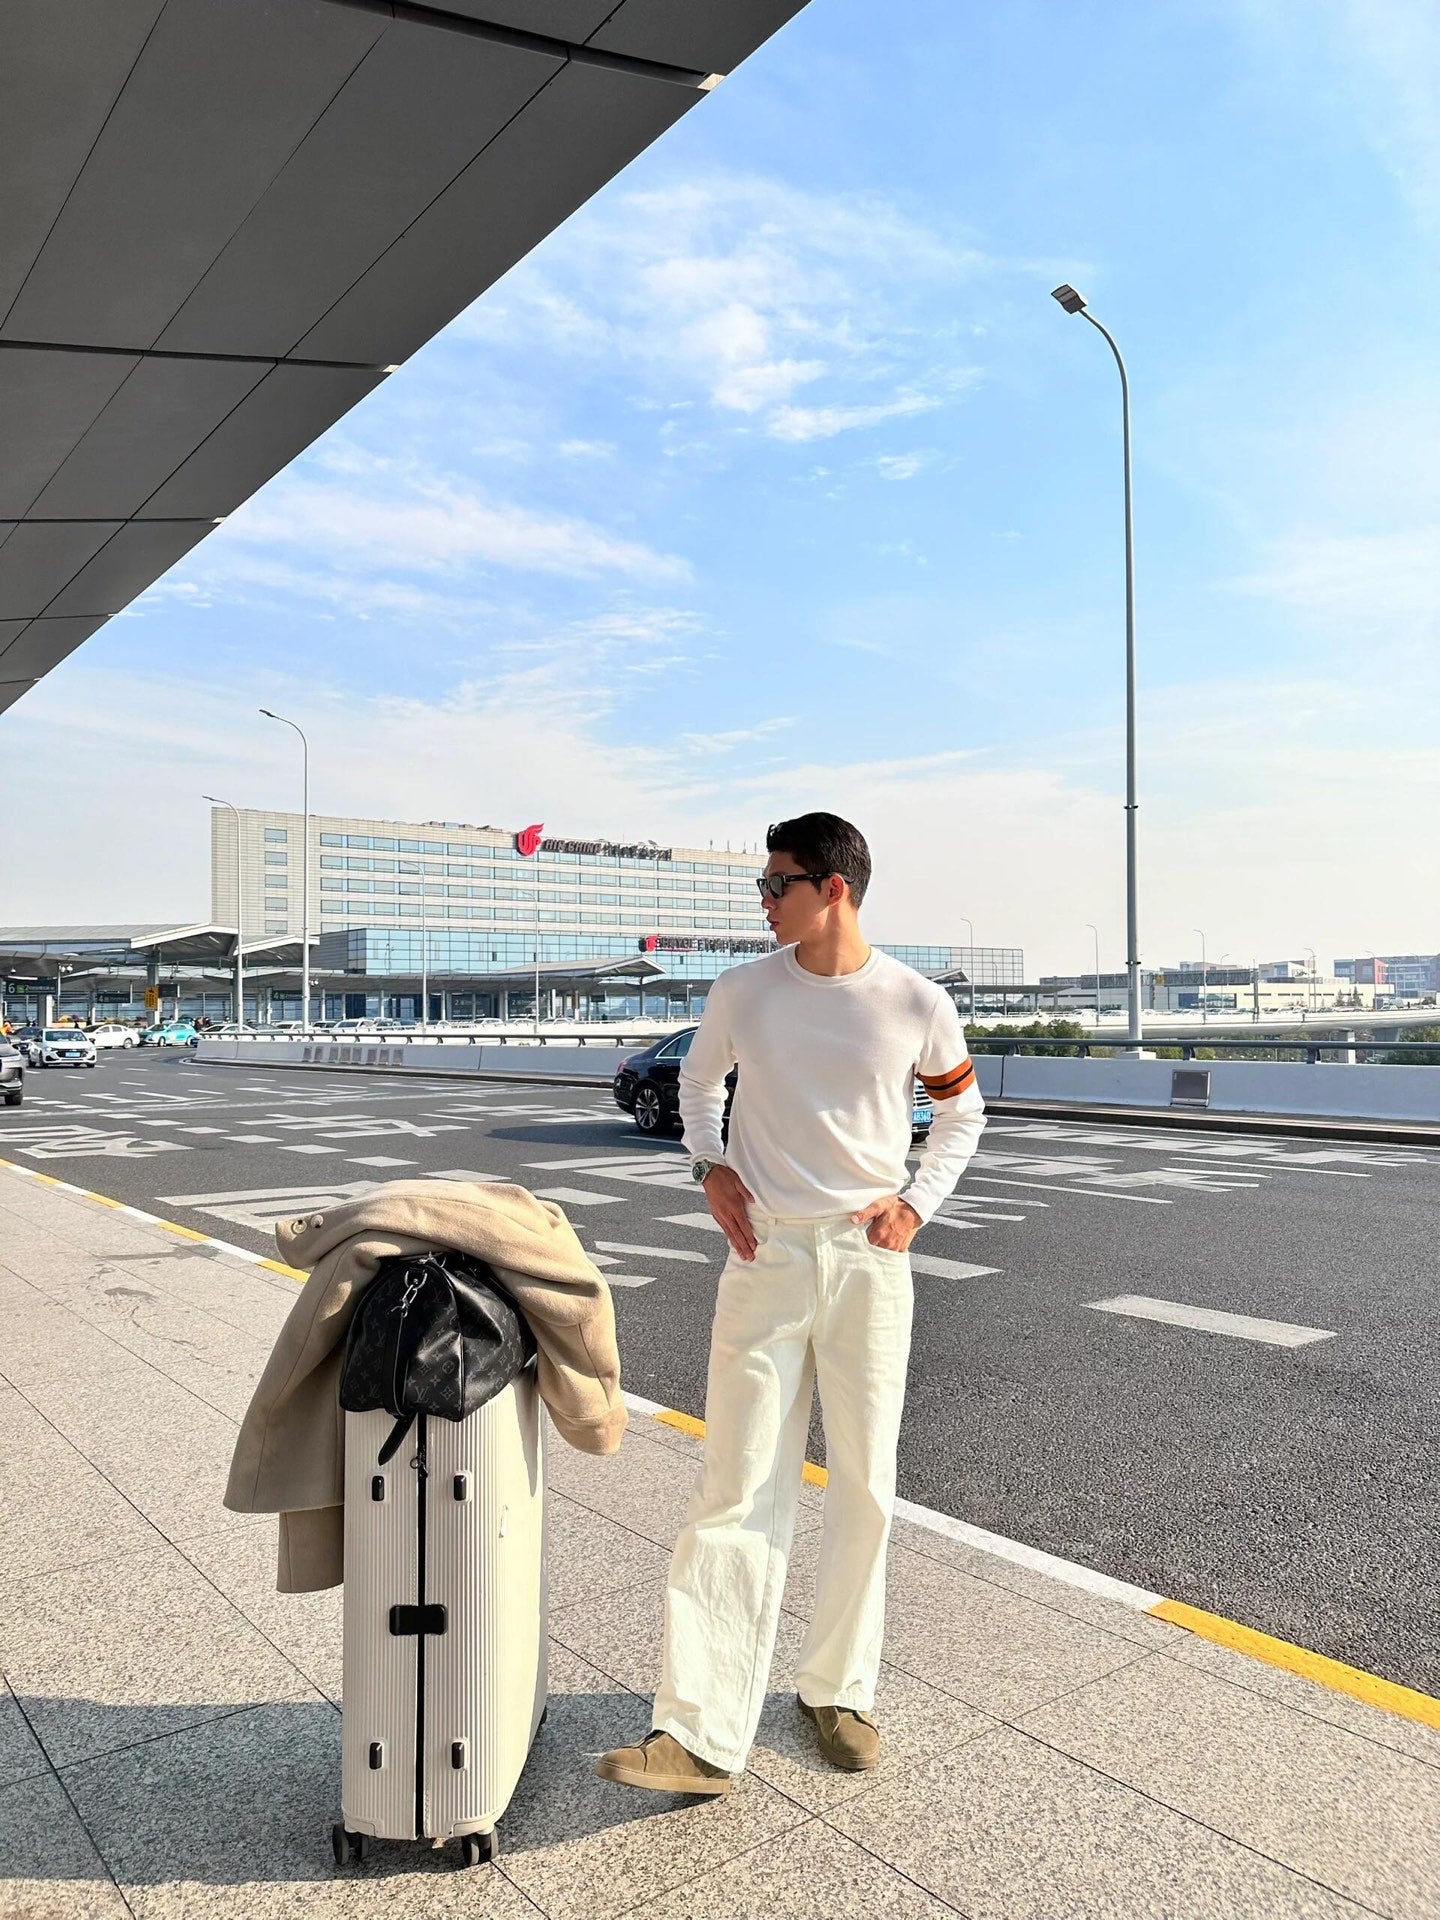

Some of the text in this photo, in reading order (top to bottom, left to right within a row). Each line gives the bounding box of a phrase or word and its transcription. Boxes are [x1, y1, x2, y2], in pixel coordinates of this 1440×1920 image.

[544, 839, 565, 851] AIR
[566, 841, 602, 854] CHINA
[8, 983, 15, 993] 6
[414, 1385, 430, 1403] LV
